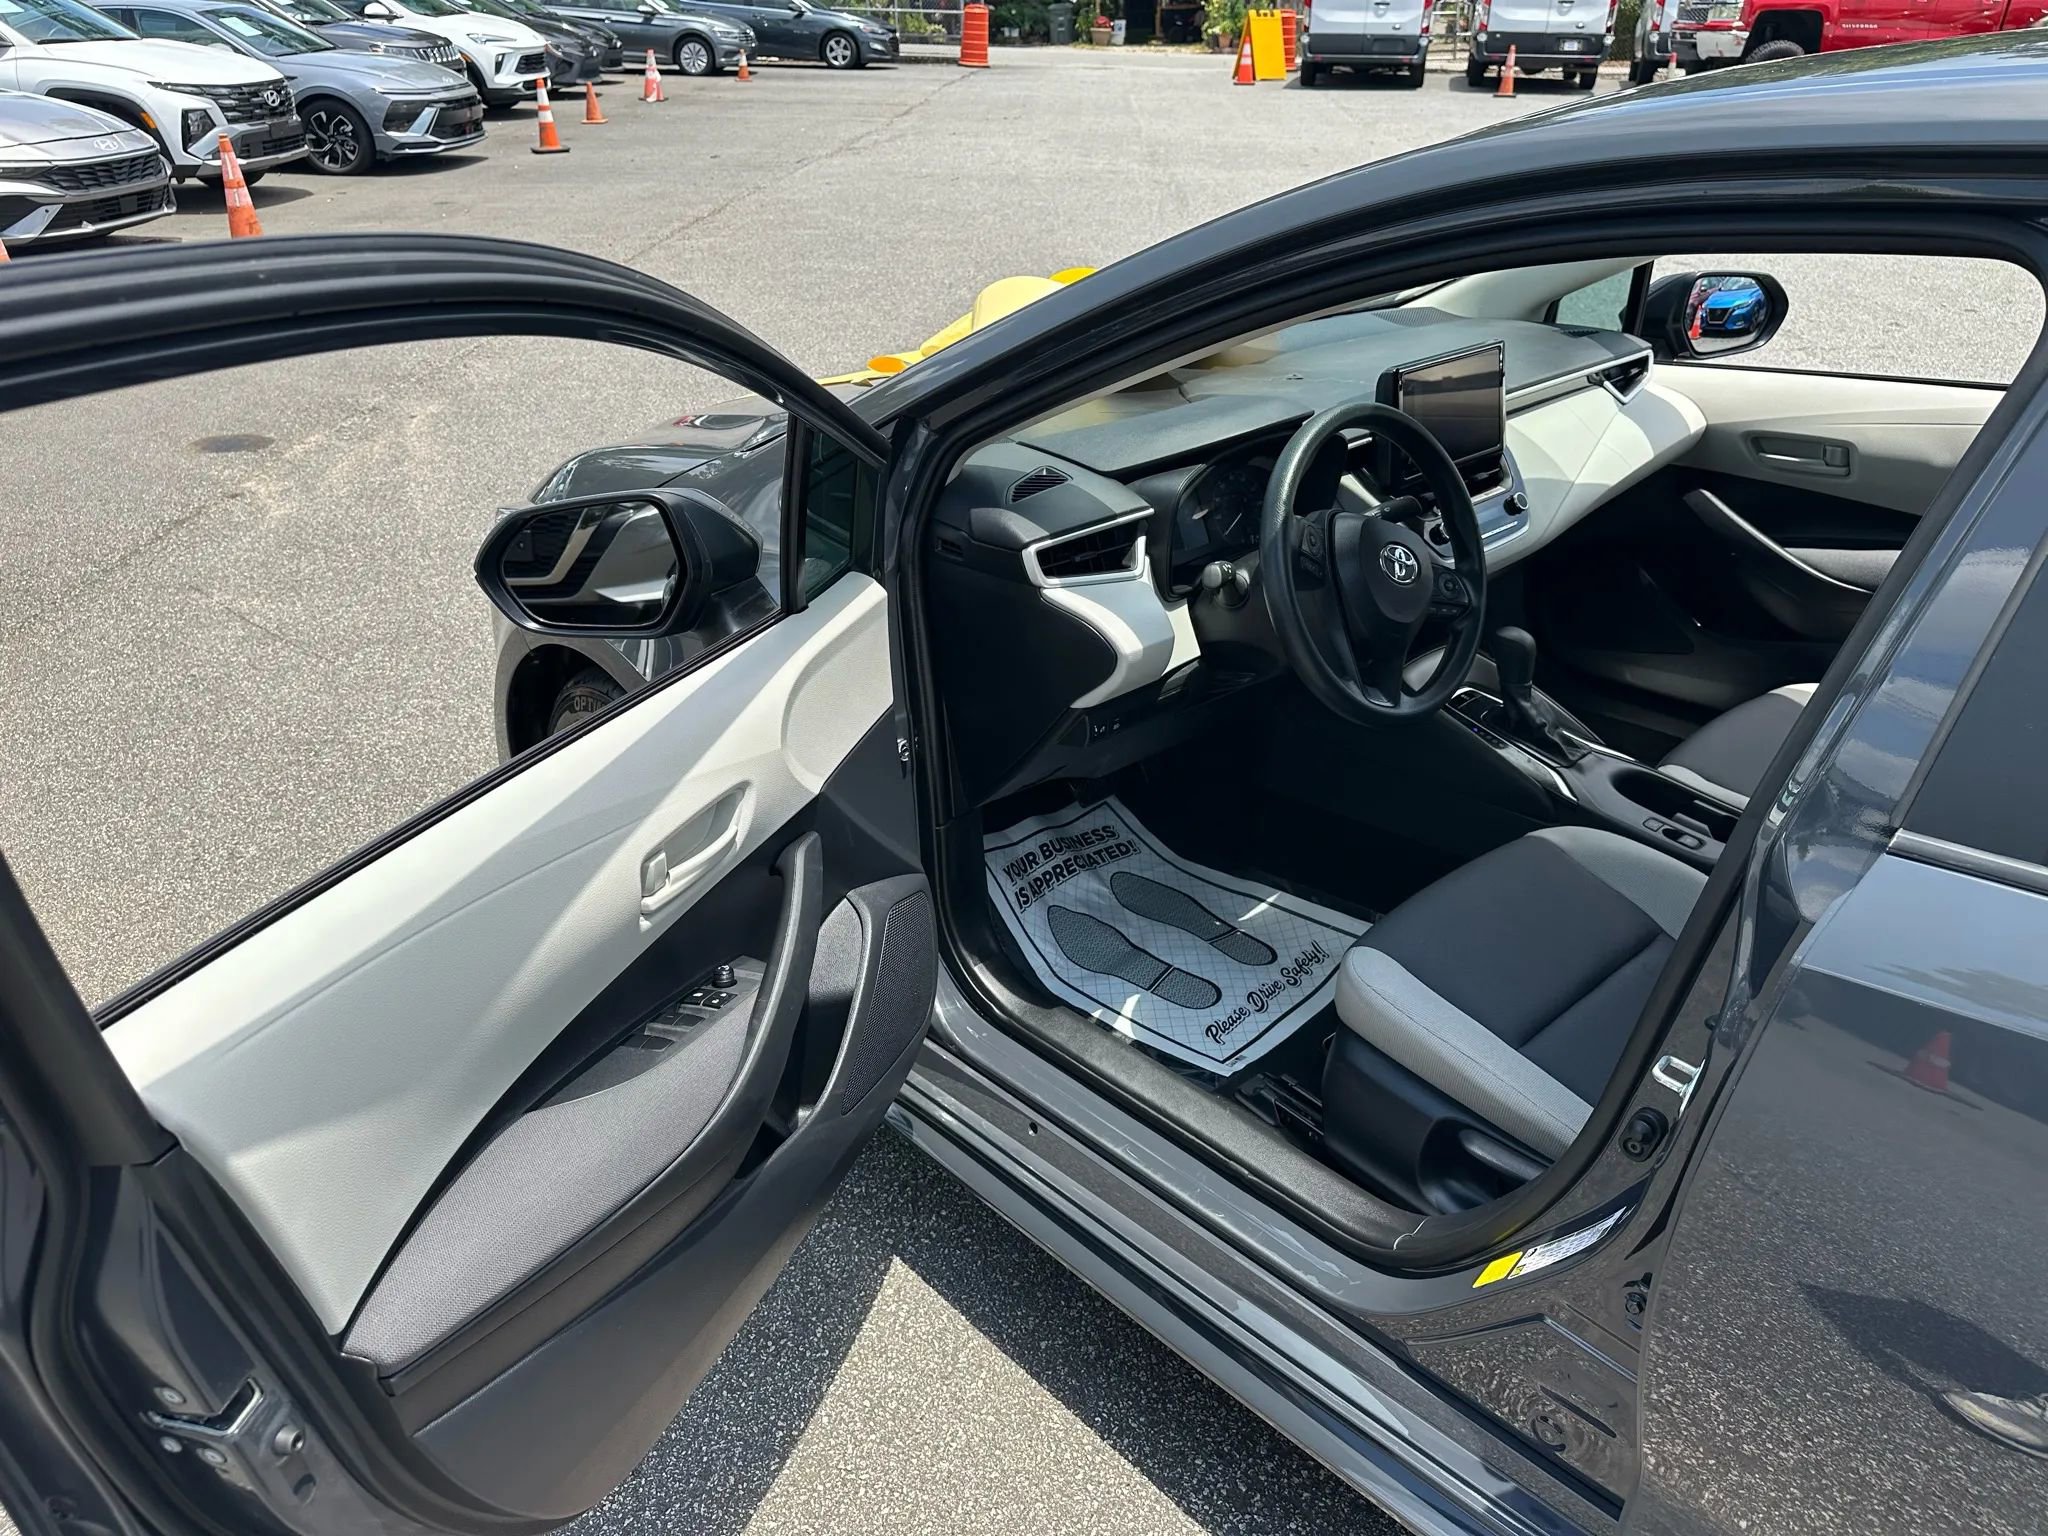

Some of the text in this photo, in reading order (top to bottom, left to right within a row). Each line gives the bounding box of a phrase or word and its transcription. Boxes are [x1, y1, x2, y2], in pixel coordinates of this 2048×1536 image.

[1003, 825, 1120, 886] YOUR BUSINESS
[1014, 839, 1142, 914] IS APPRECIATED!
[1205, 939, 1330, 1045] Please Drive Safely!
